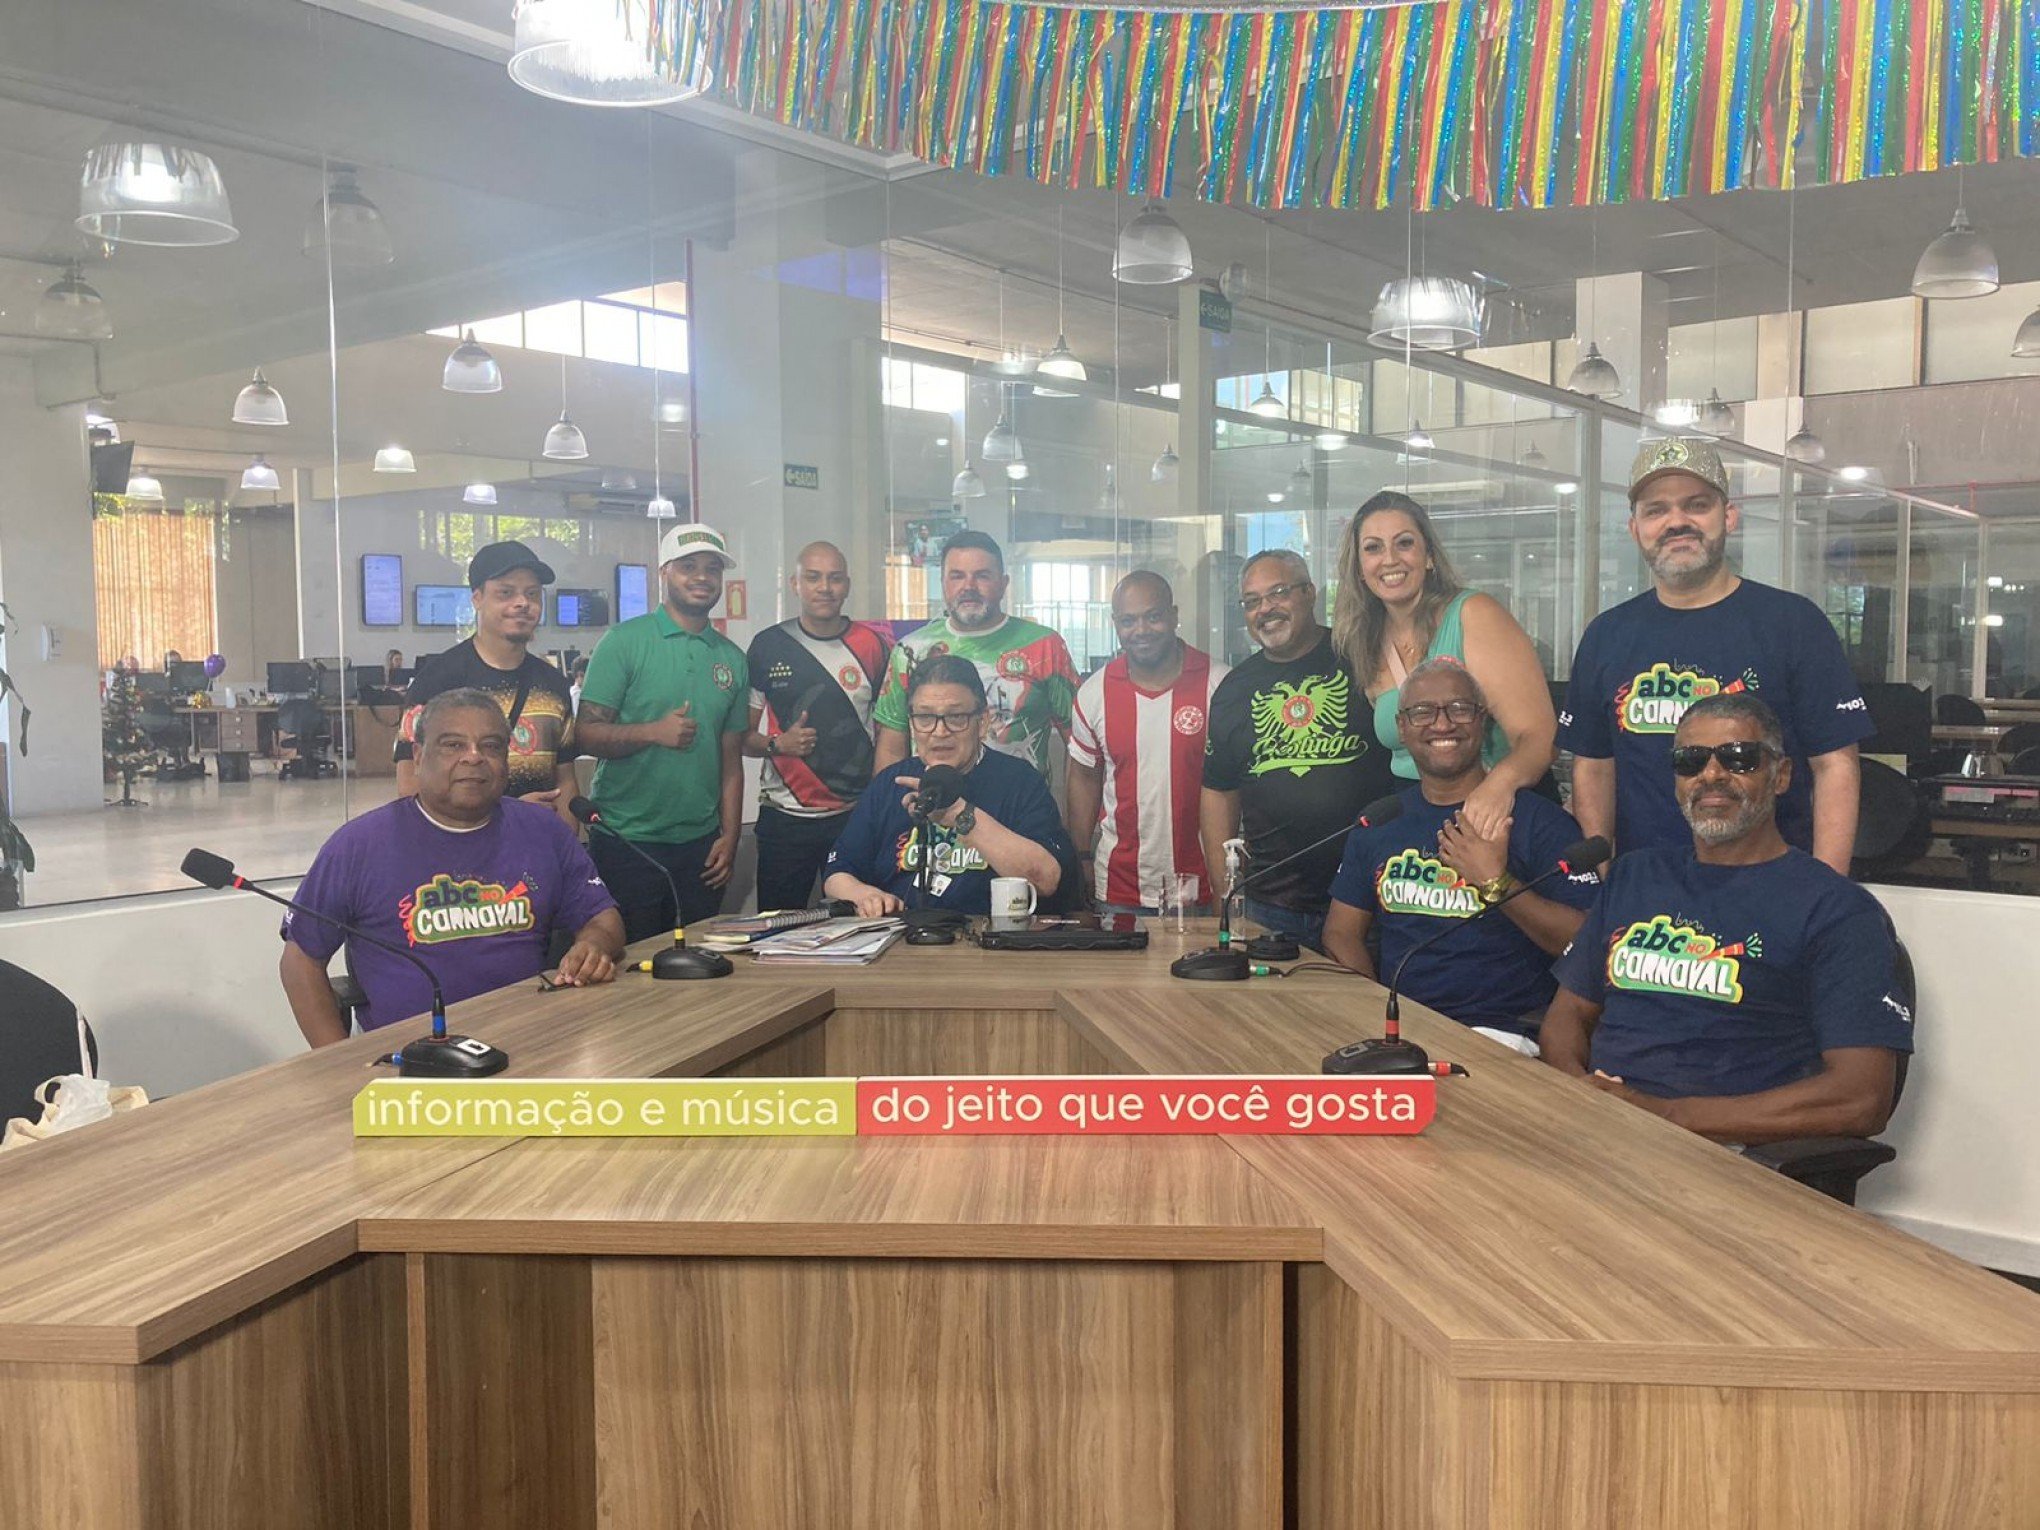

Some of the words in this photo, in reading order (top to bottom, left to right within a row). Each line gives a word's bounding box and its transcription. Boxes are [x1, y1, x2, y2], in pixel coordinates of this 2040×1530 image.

[1638, 671, 1693, 698] abc
[1628, 698, 1698, 725] CARN
[1388, 856, 1437, 883] abc
[423, 881, 480, 909] abc
[1627, 923, 1688, 954] abc
[368, 1090, 625, 1134] informação
[640, 1098, 666, 1126] e
[682, 1089, 839, 1126] música
[872, 1087, 931, 1122] do
[942, 1087, 1042, 1129] jeito
[1060, 1095, 1144, 1129] que
[1160, 1086, 1270, 1123] você
[1286, 1091, 1416, 1129] gosta
